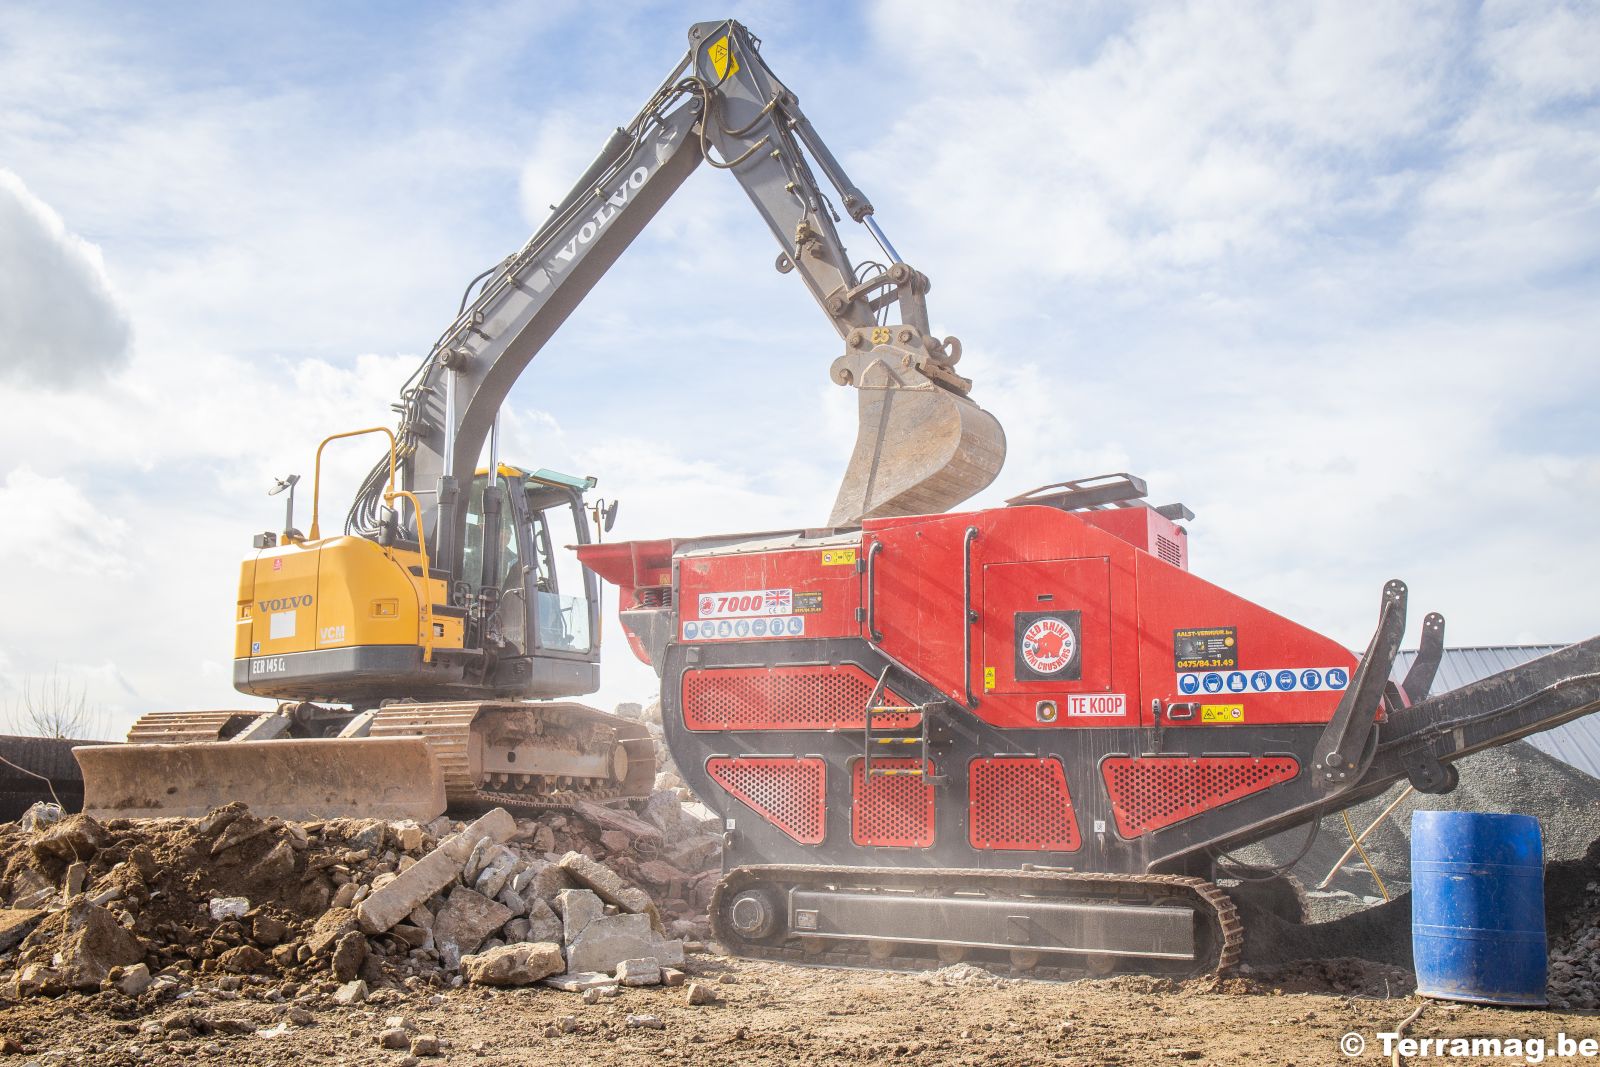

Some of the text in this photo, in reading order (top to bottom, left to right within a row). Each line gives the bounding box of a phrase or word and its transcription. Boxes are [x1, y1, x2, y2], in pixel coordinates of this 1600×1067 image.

[554, 166, 648, 261] VOLVO
[258, 594, 313, 613] VOLVO
[717, 595, 764, 613] 7000
[319, 625, 345, 640] VCM
[1025, 621, 1070, 643] RED RHINO
[252, 659, 265, 674] ECR
[266, 658, 278, 673] 145
[1025, 648, 1071, 671] MINI CRUSHERS
[1071, 697, 1123, 713] TE KOOP
